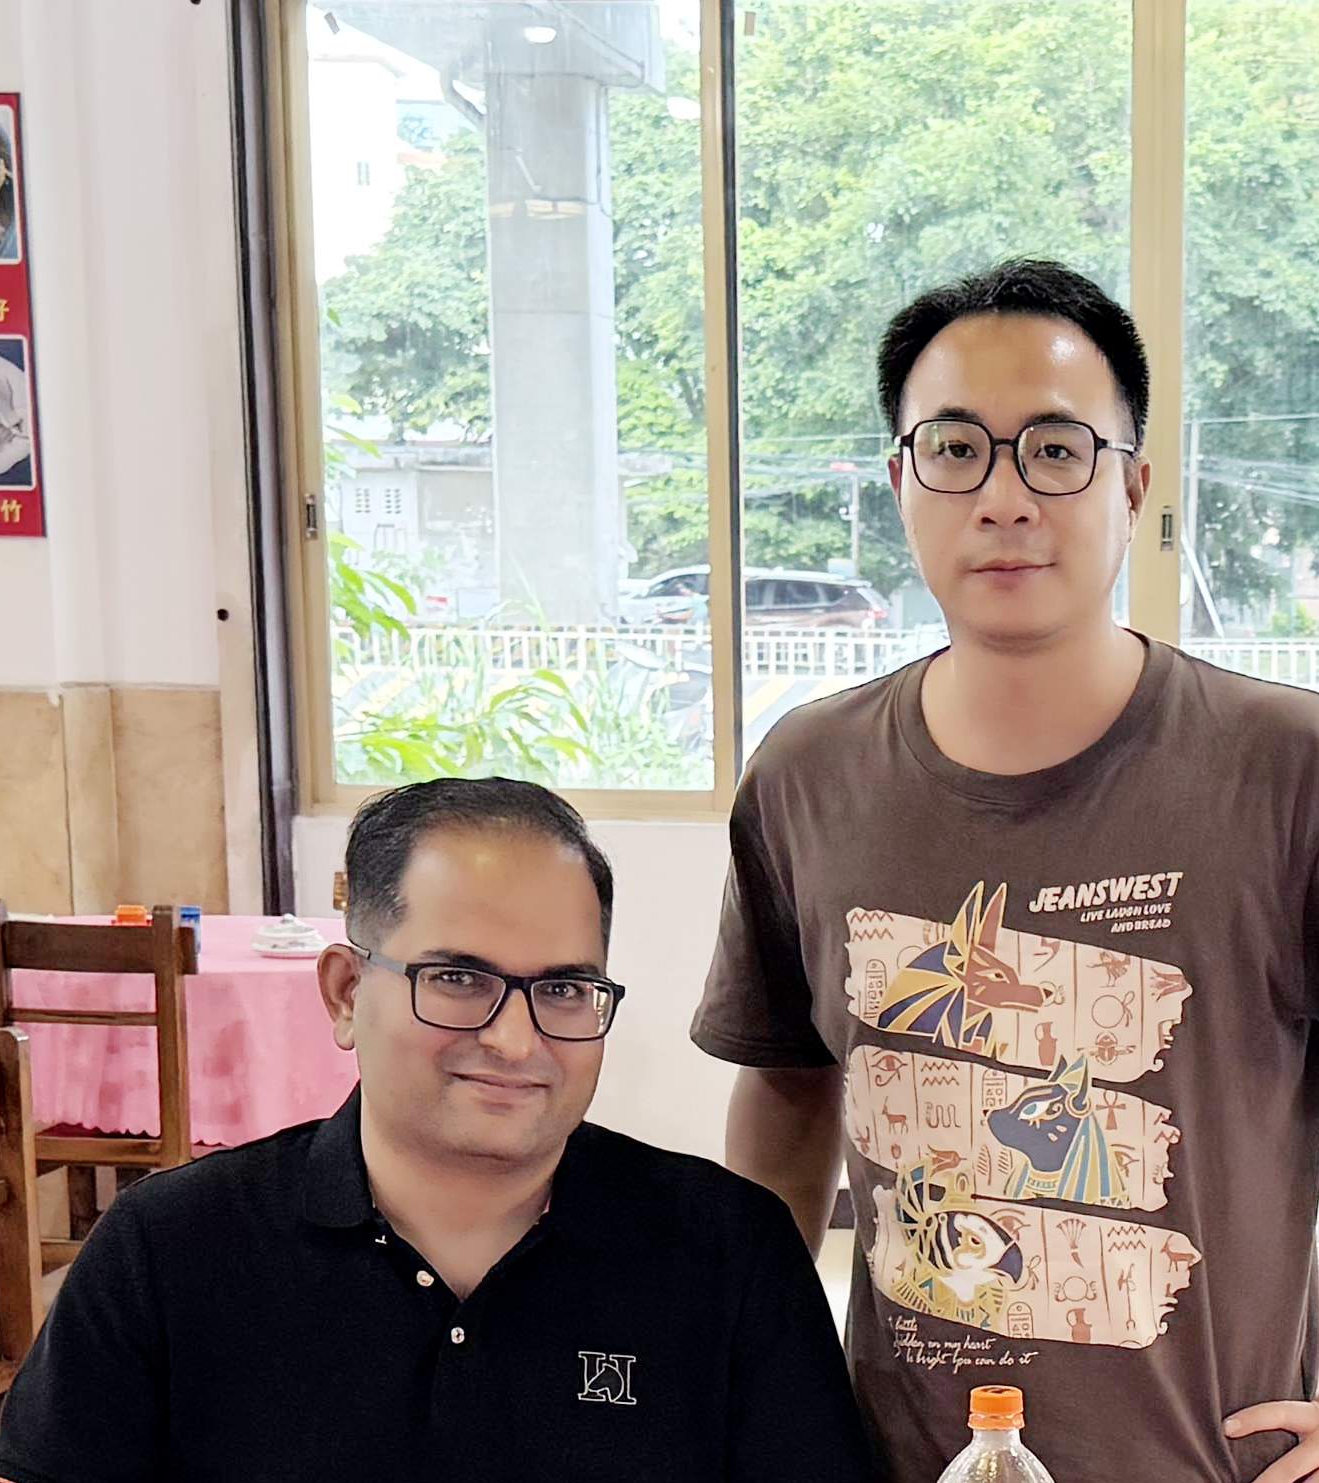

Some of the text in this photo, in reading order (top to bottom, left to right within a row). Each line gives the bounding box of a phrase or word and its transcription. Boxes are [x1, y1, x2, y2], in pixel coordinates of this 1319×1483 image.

[1028, 872, 1184, 912] JEANSWEST
[1081, 910, 1104, 922] LIVE
[1144, 903, 1172, 916] LOVE
[1110, 918, 1171, 933] AND BREAD
